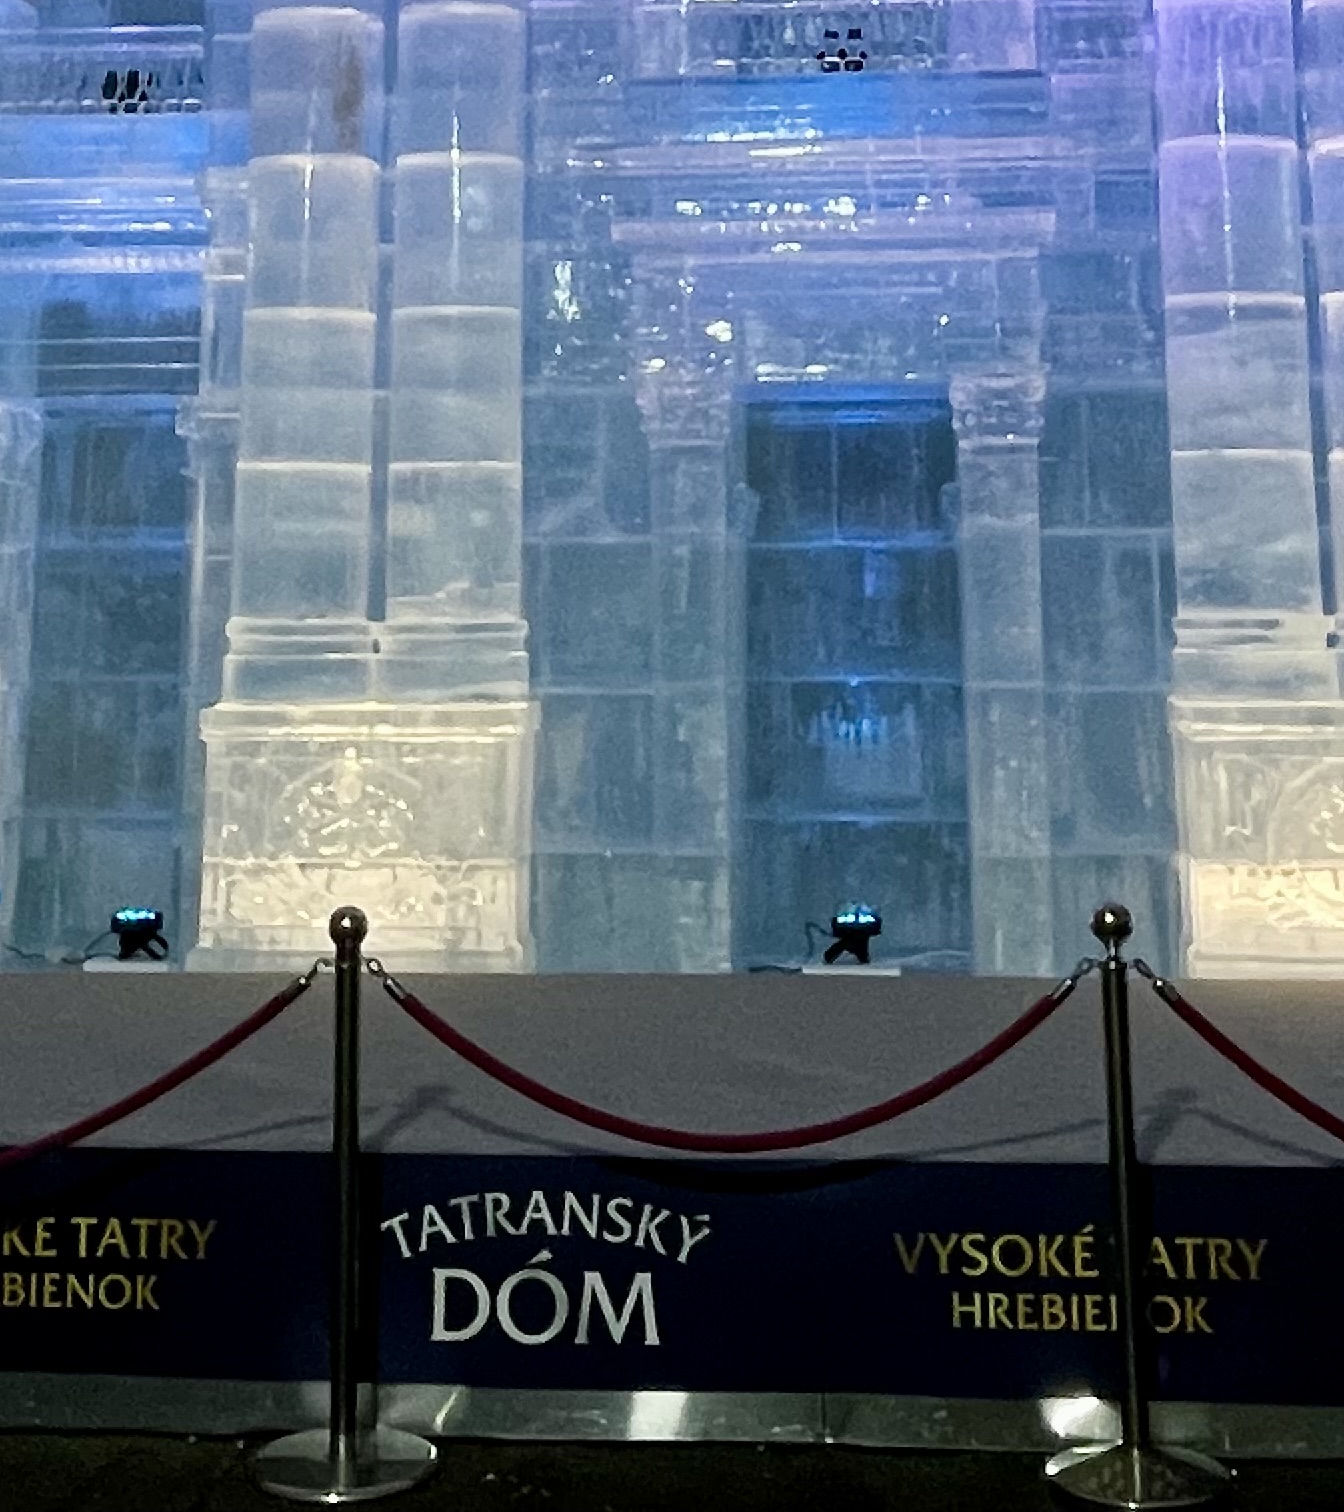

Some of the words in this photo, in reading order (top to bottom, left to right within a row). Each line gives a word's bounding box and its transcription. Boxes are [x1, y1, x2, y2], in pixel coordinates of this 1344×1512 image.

[70, 1216, 218, 1259] TATRY
[380, 1190, 711, 1264] TATRANSKÝ
[892, 1224, 1100, 1278] VYSOKÉ
[1144, 1236, 1269, 1281] ATRY
[430, 1247, 661, 1346] DÓM
